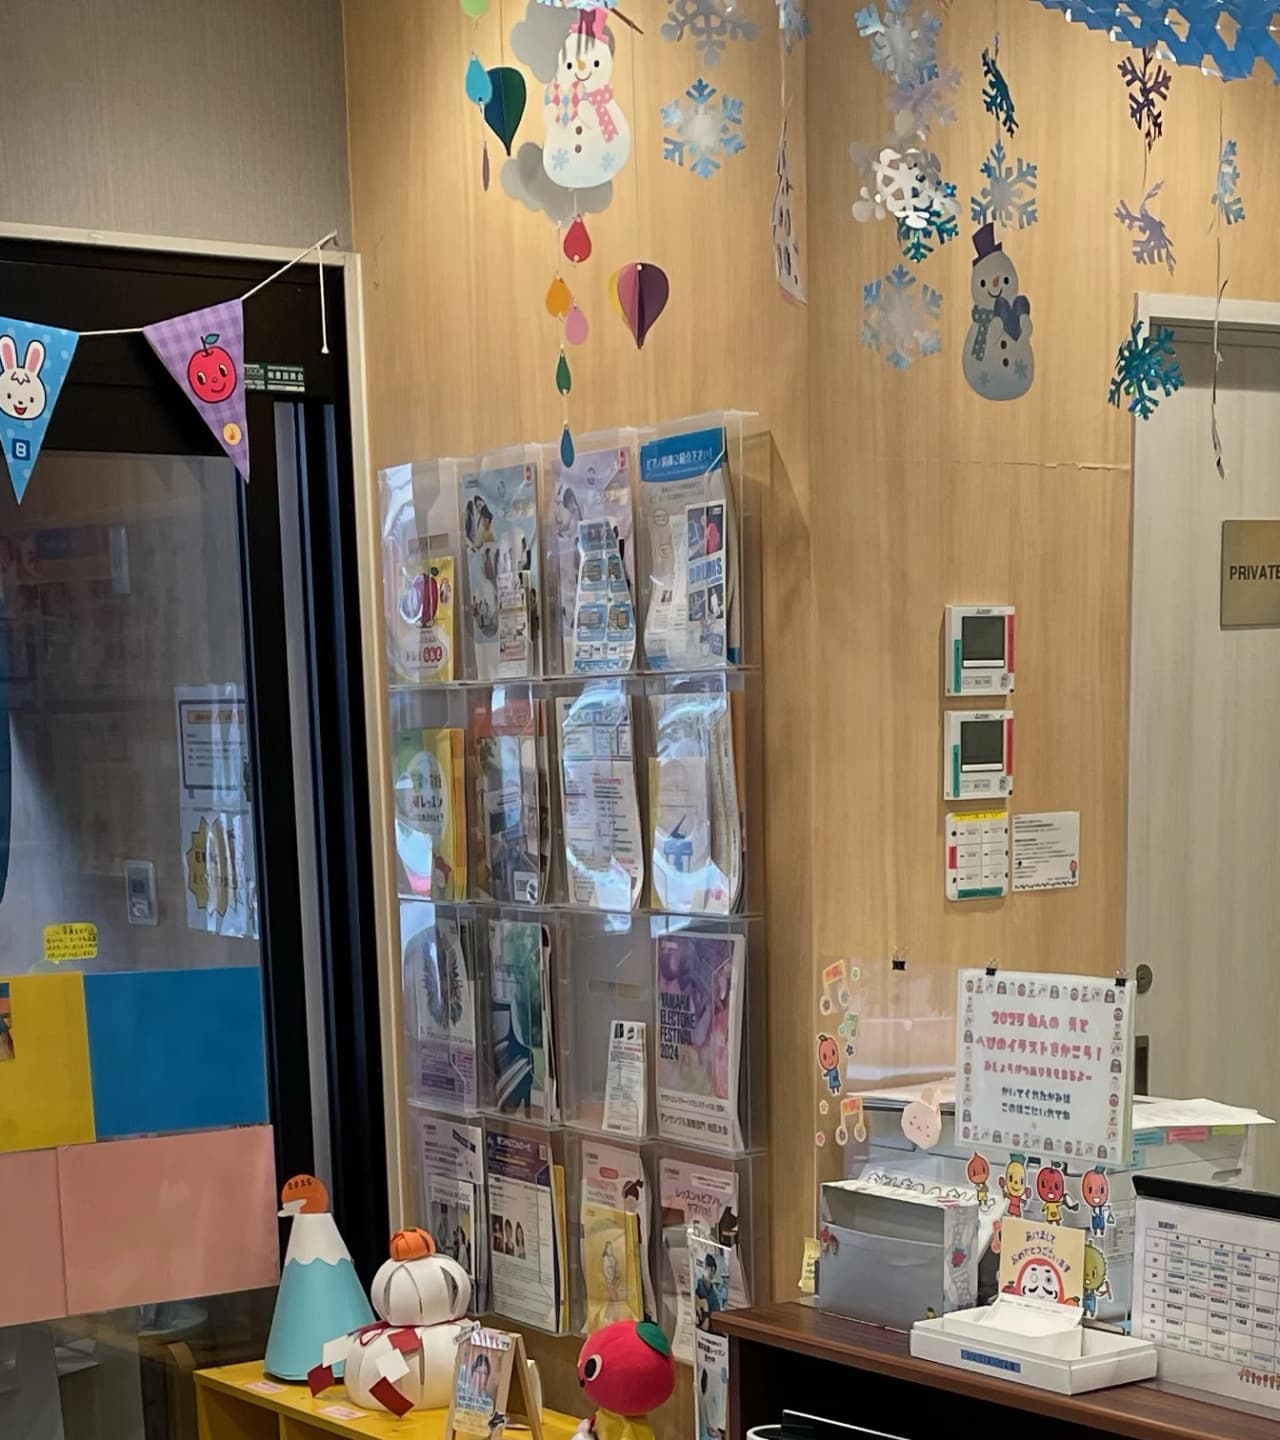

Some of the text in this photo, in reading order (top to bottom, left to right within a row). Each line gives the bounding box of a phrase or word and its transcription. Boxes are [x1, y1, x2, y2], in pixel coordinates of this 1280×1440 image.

[15, 442, 27, 458] B
[660, 991, 691, 1012] YAMAHA
[660, 1009, 696, 1030] ELECTONE
[660, 1026, 694, 1047] FESTIVAL
[660, 1043, 679, 1061] 2024
